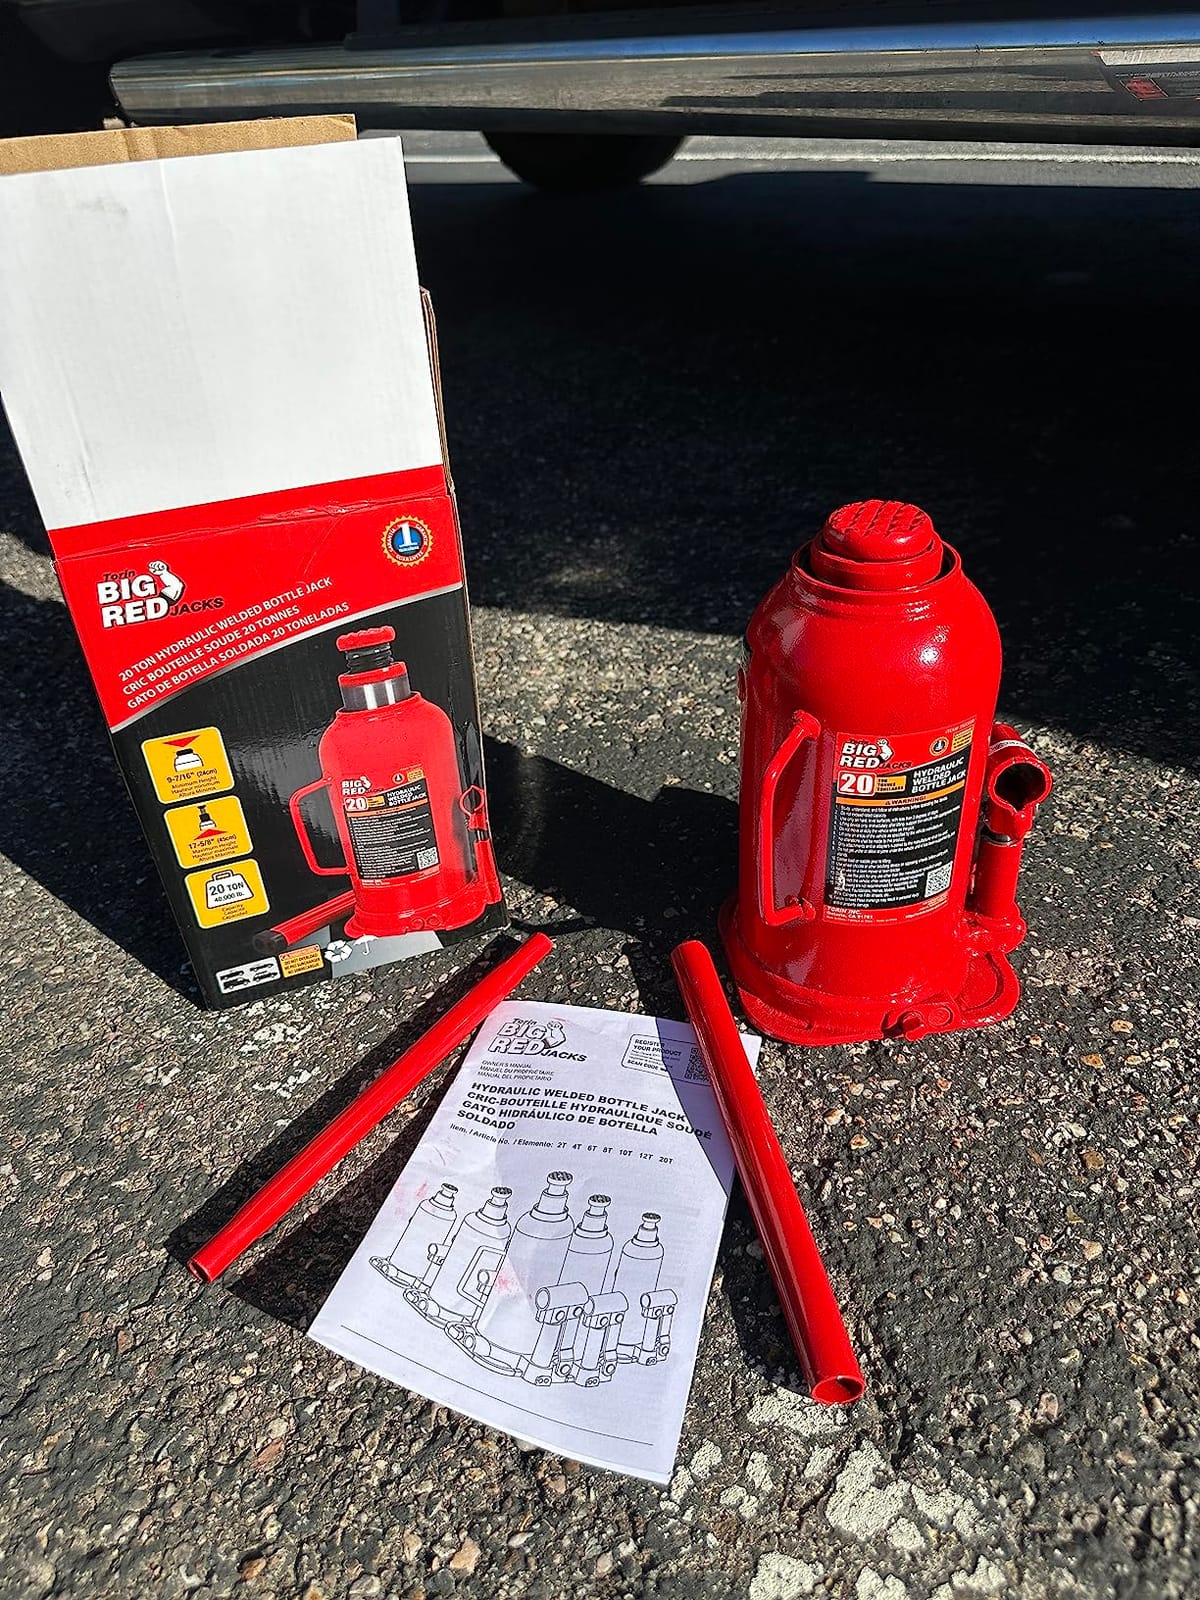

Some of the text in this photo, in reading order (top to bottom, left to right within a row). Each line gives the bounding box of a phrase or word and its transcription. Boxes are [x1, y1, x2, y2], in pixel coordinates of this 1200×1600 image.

[103, 569, 135, 581] Torin
[97, 574, 156, 604] BIG
[102, 597, 224, 628] RED JACKS
[118, 577, 333, 681] 20 TON HYDRAULIC WELDED BOTTLE JACK
[122, 605, 300, 695] CRIC BOUTEILLE SOUDE 20 TONNES
[127, 601, 350, 709] GATO DE BOTELLA SOLDADA 20 TONELADAS
[842, 742, 878, 757] BIG
[839, 755, 880, 769] RED
[913, 756, 965, 778] HYDRAULIC
[341, 779, 362, 788] BIG
[839, 773, 873, 794] 20
[911, 769, 967, 794] BOTTLE JACK
[912, 770, 951, 786] WELDED
[342, 787, 366, 796] RED
[345, 797, 367, 810] 20
[209, 881, 244, 896] 20 TON
[214, 892, 236, 903] 40,000
[497, 1021, 547, 1040] BIG
[488, 1036, 588, 1062] RED JACKS
[634, 1039, 666, 1048] REGISTER
[651, 1047, 682, 1056] PRODUCT
[627, 1059, 643, 1067] SCAN
[477, 1071, 501, 1079] MANUAL
[471, 1082, 687, 1122] HYDRAULIC WELDED BOTTLE JACK
[457, 1109, 516, 1130] SOLDADO
[462, 1100, 658, 1135] GATO HIDRÁULICO DE BOTELLA
[467, 1091, 713, 1140] CRIC-BOUTEILLE HYDRAULIQUE SOUDÉ
[587, 1144, 598, 1152] 6T
[602, 1146, 613, 1154] 8T
[619, 1149, 633, 1157] 10T
[639, 1152, 653, 1161] 12T
[658, 1156, 674, 1165] 20T
